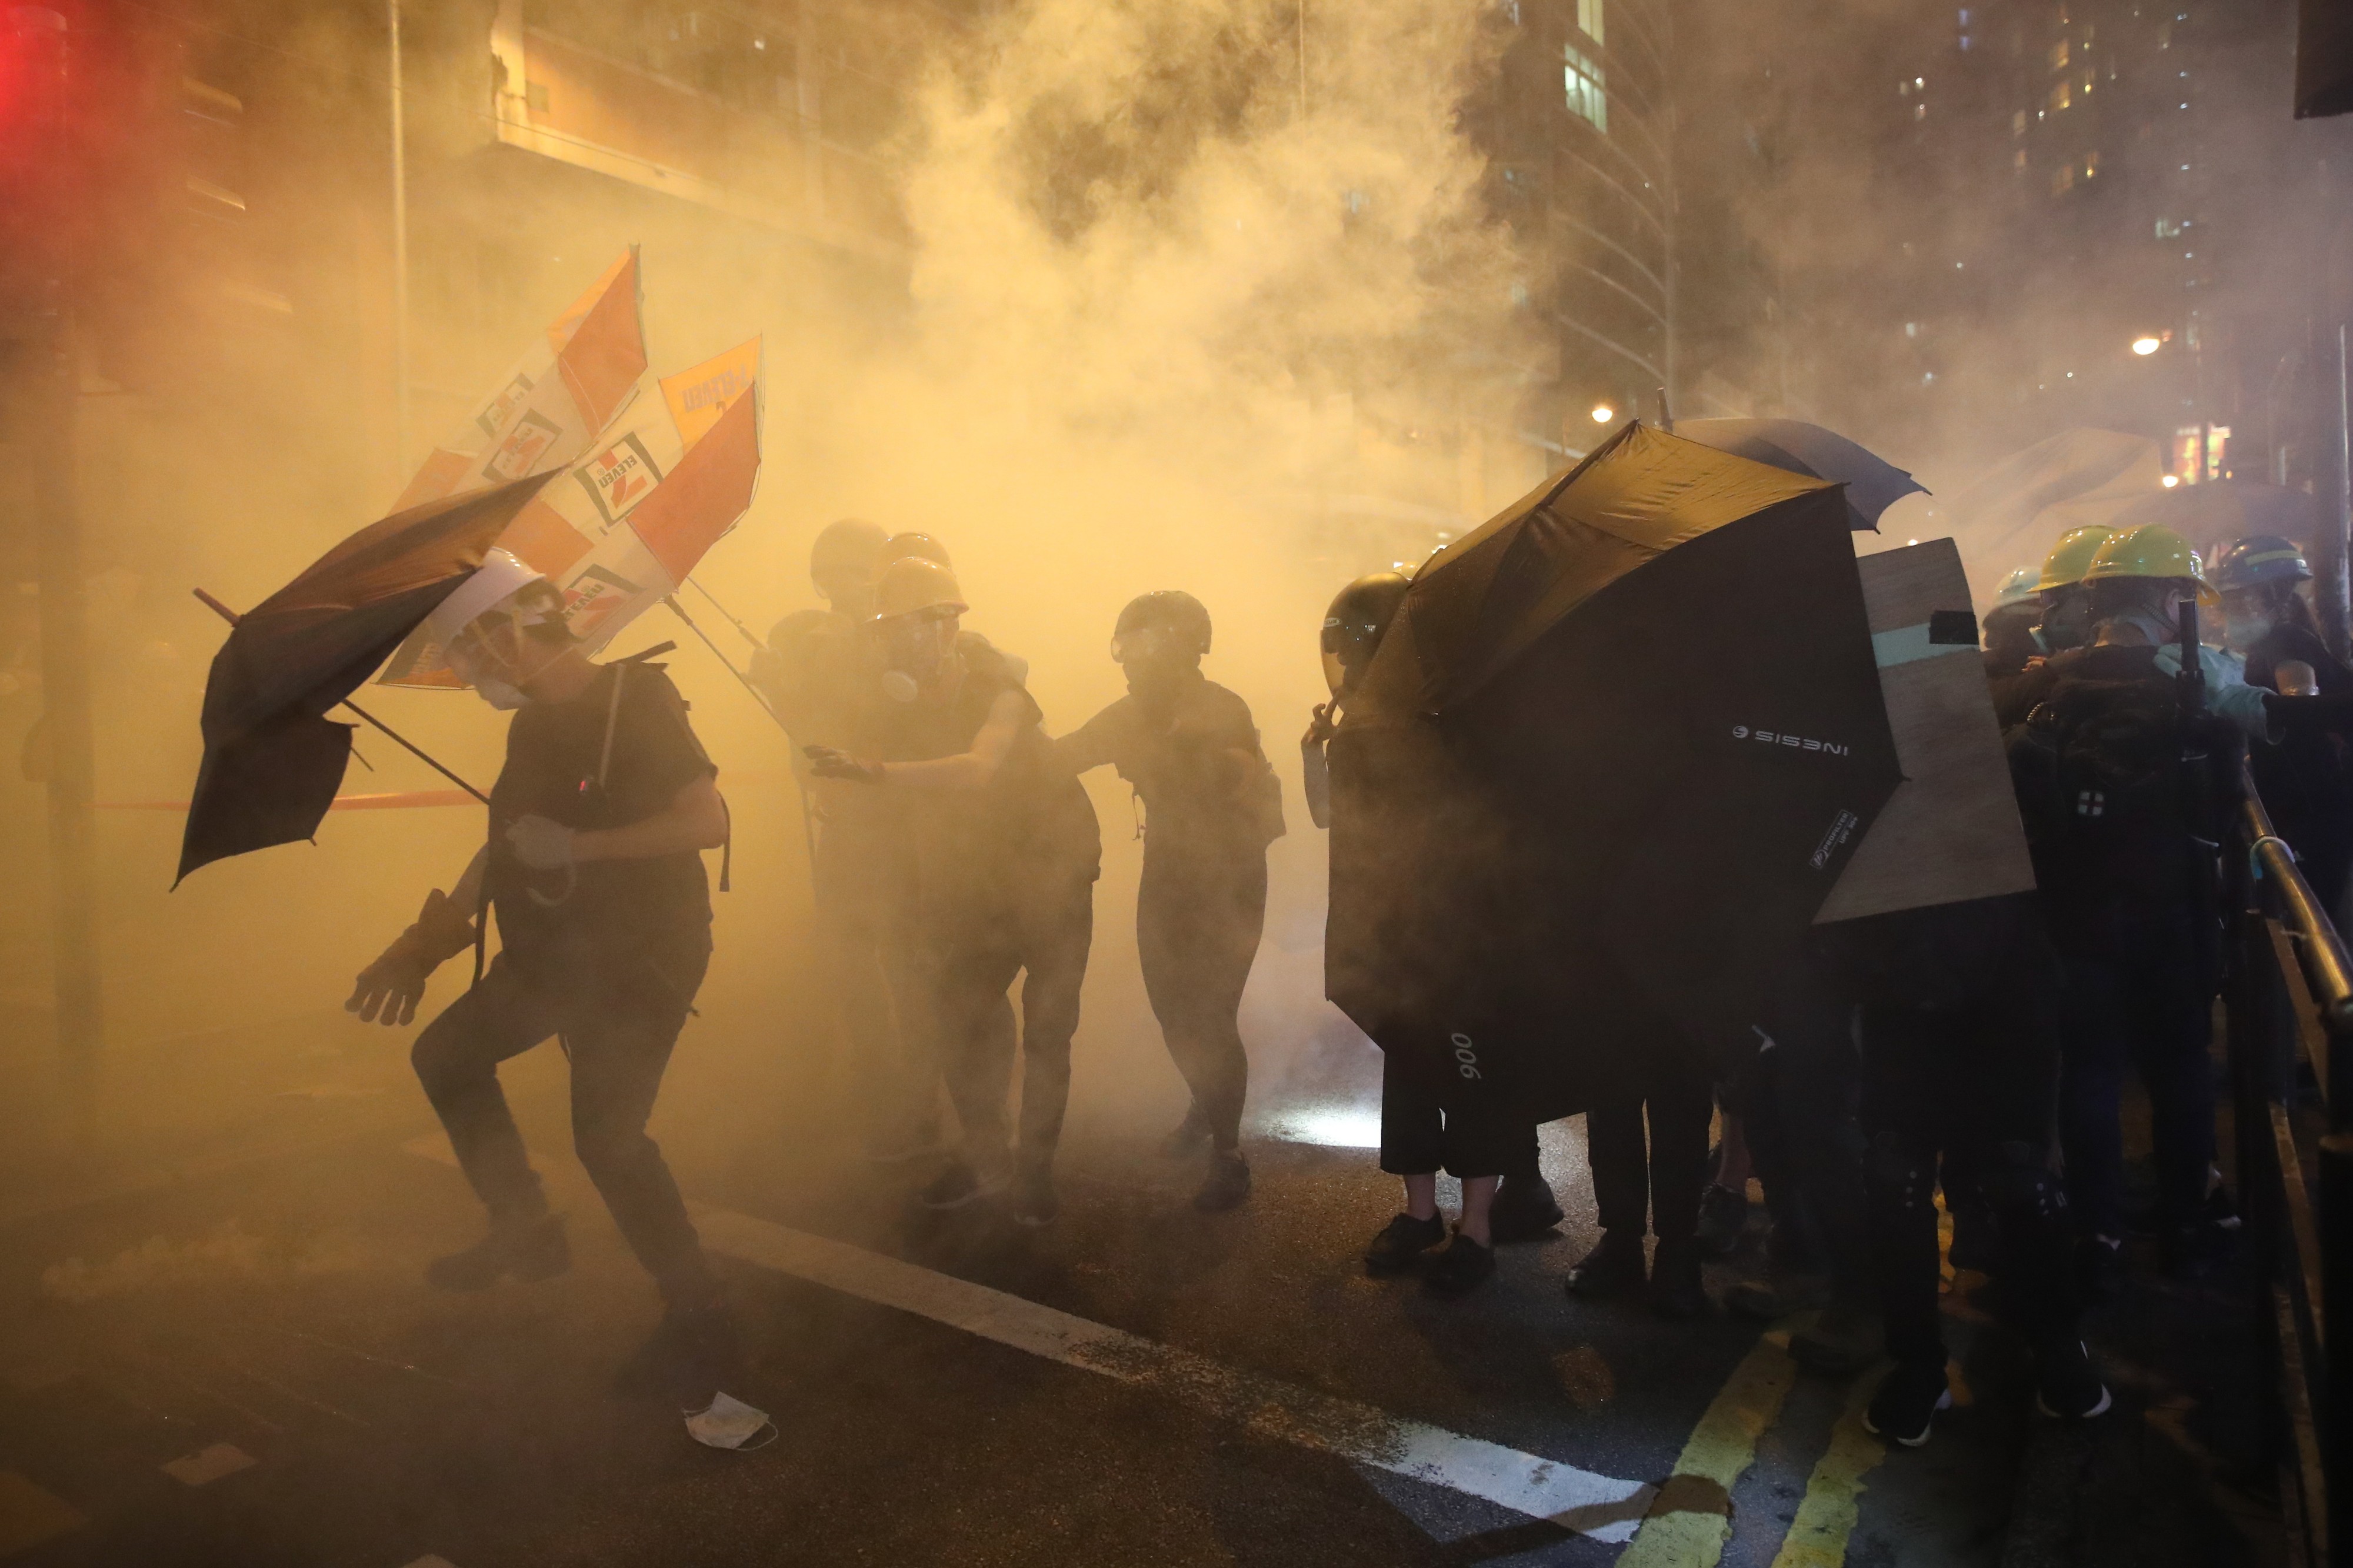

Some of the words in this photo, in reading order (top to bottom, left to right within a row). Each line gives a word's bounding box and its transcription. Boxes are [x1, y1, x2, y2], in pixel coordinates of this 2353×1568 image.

[1755, 730, 1848, 756] INESIS
[1823, 813, 1848, 850] PROFILTER
[1451, 1033, 1481, 1079] 900
